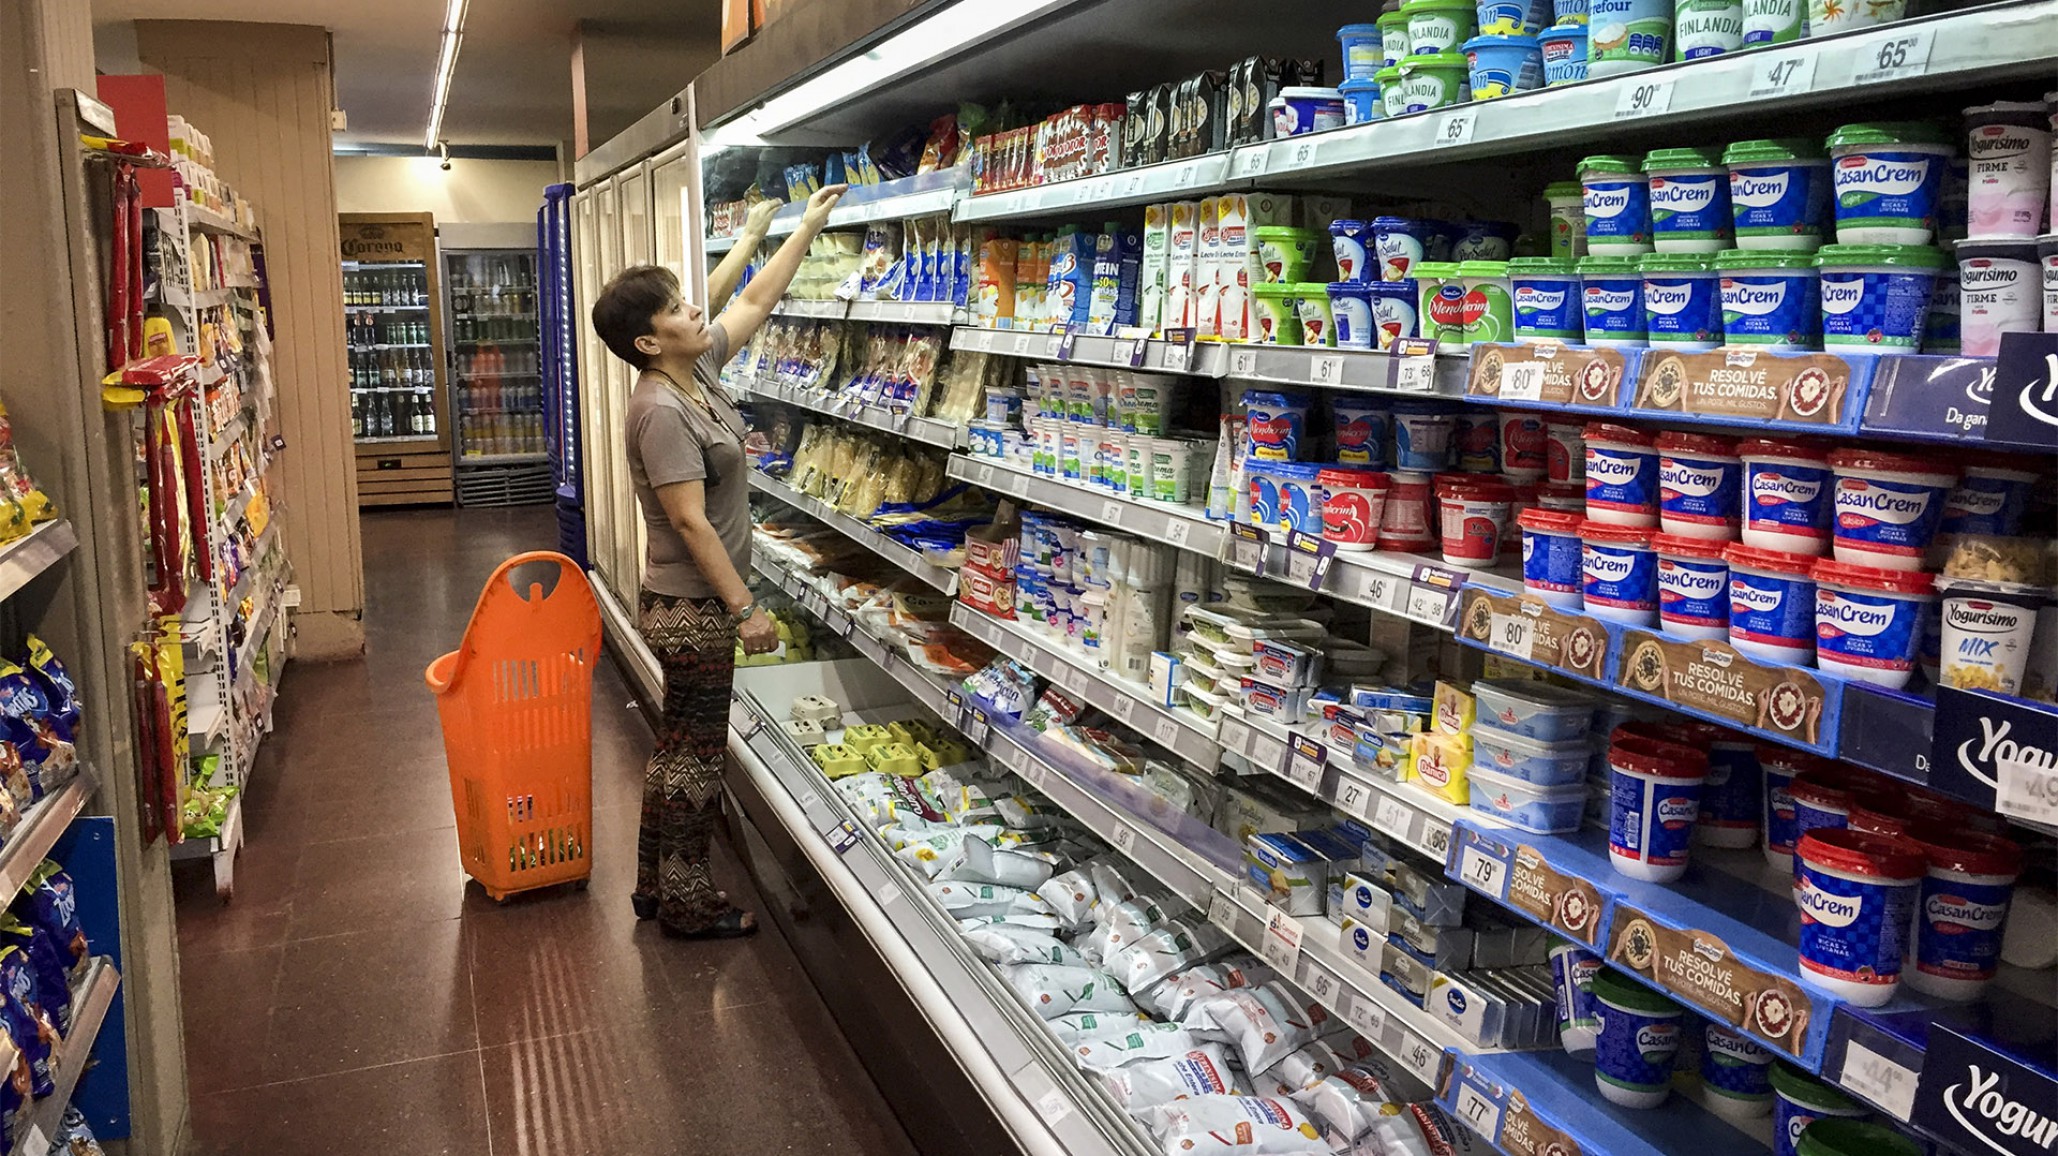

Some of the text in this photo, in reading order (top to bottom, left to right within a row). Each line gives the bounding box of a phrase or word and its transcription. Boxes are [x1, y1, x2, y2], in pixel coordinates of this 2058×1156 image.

[1836, 163, 1921, 188] CasanCrem
[1977, 162, 2009, 173] FIRME
[341, 240, 404, 256] Corona
[1967, 293, 1998, 304] FIRME
[1709, 367, 1767, 386] RESOLVÉ
[1693, 382, 1778, 400] TUS COMIDAS.
[1754, 478, 1816, 496] CasanCrem
[1836, 487, 1921, 514] CasanCrem
[1950, 603, 2017, 628] Yogurísimo
[1959, 637, 1999, 657] MIX
[1688, 662, 1744, 689] RESOLVÉ
[1673, 671, 1756, 707] TUS COMIDAS.
[1345, 785, 1360, 805] 27
[1477, 857, 1492, 882] 79
[1679, 950, 1733, 986] RESOLVÉ
[1664, 955, 1743, 1008] TUS COMIDAS.
[1469, 1095, 1486, 1122] 77
